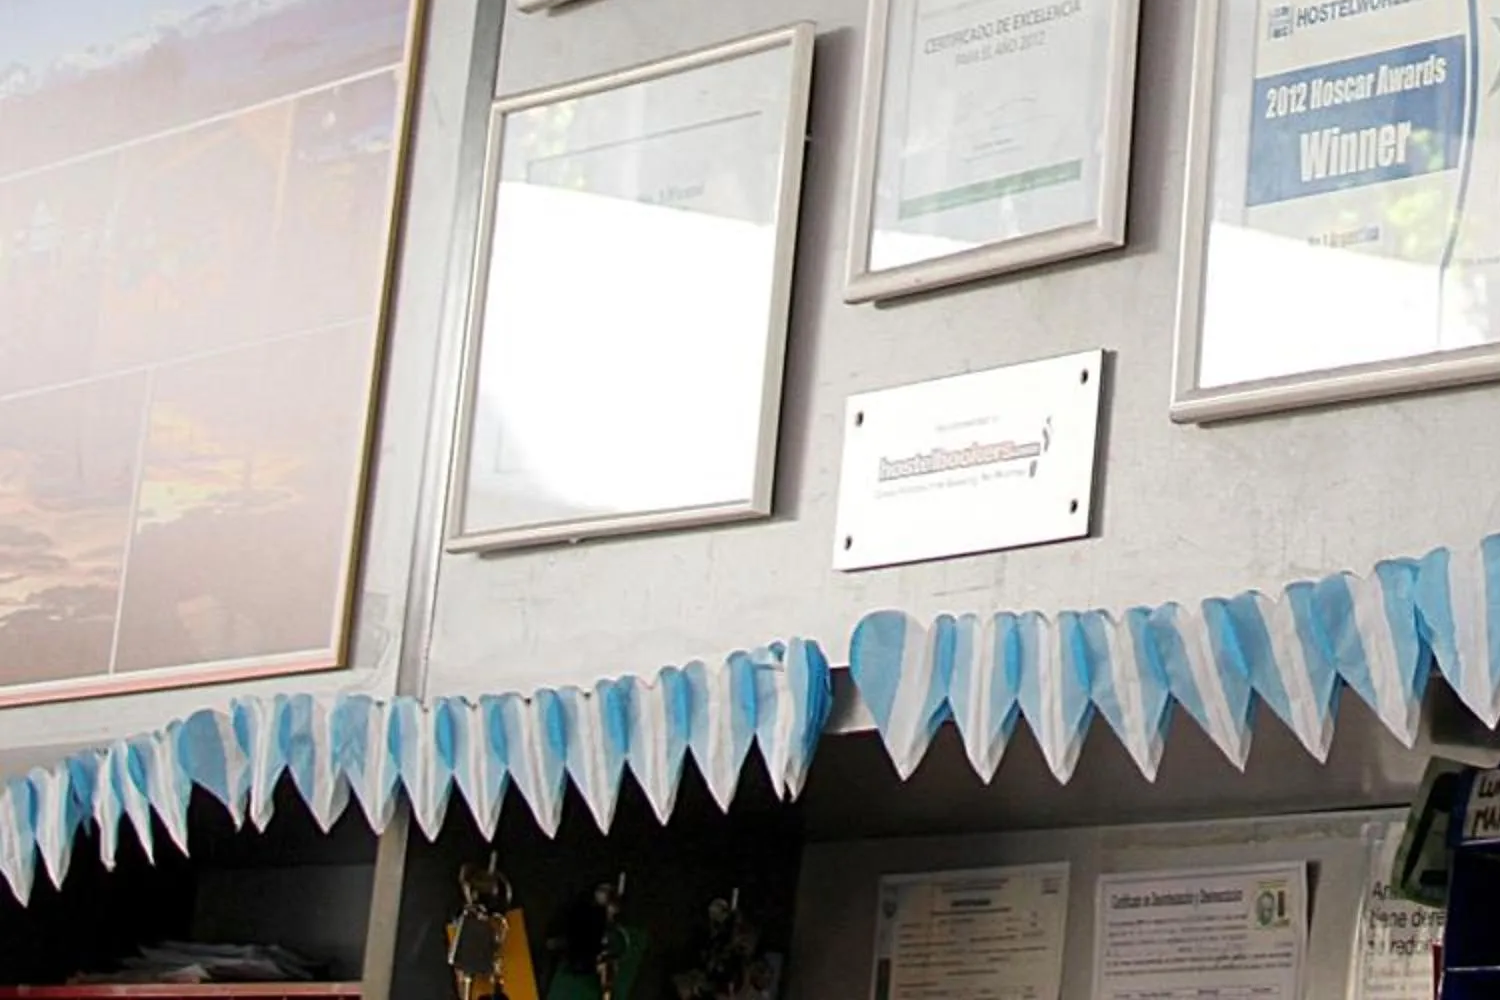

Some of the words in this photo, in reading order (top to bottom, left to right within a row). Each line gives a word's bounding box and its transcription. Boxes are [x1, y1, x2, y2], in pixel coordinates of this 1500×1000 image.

[1264, 82, 1308, 119] 2012
[1309, 71, 1375, 110] Hoscar
[1375, 54, 1448, 97] Awards
[1300, 119, 1412, 183] Winner
